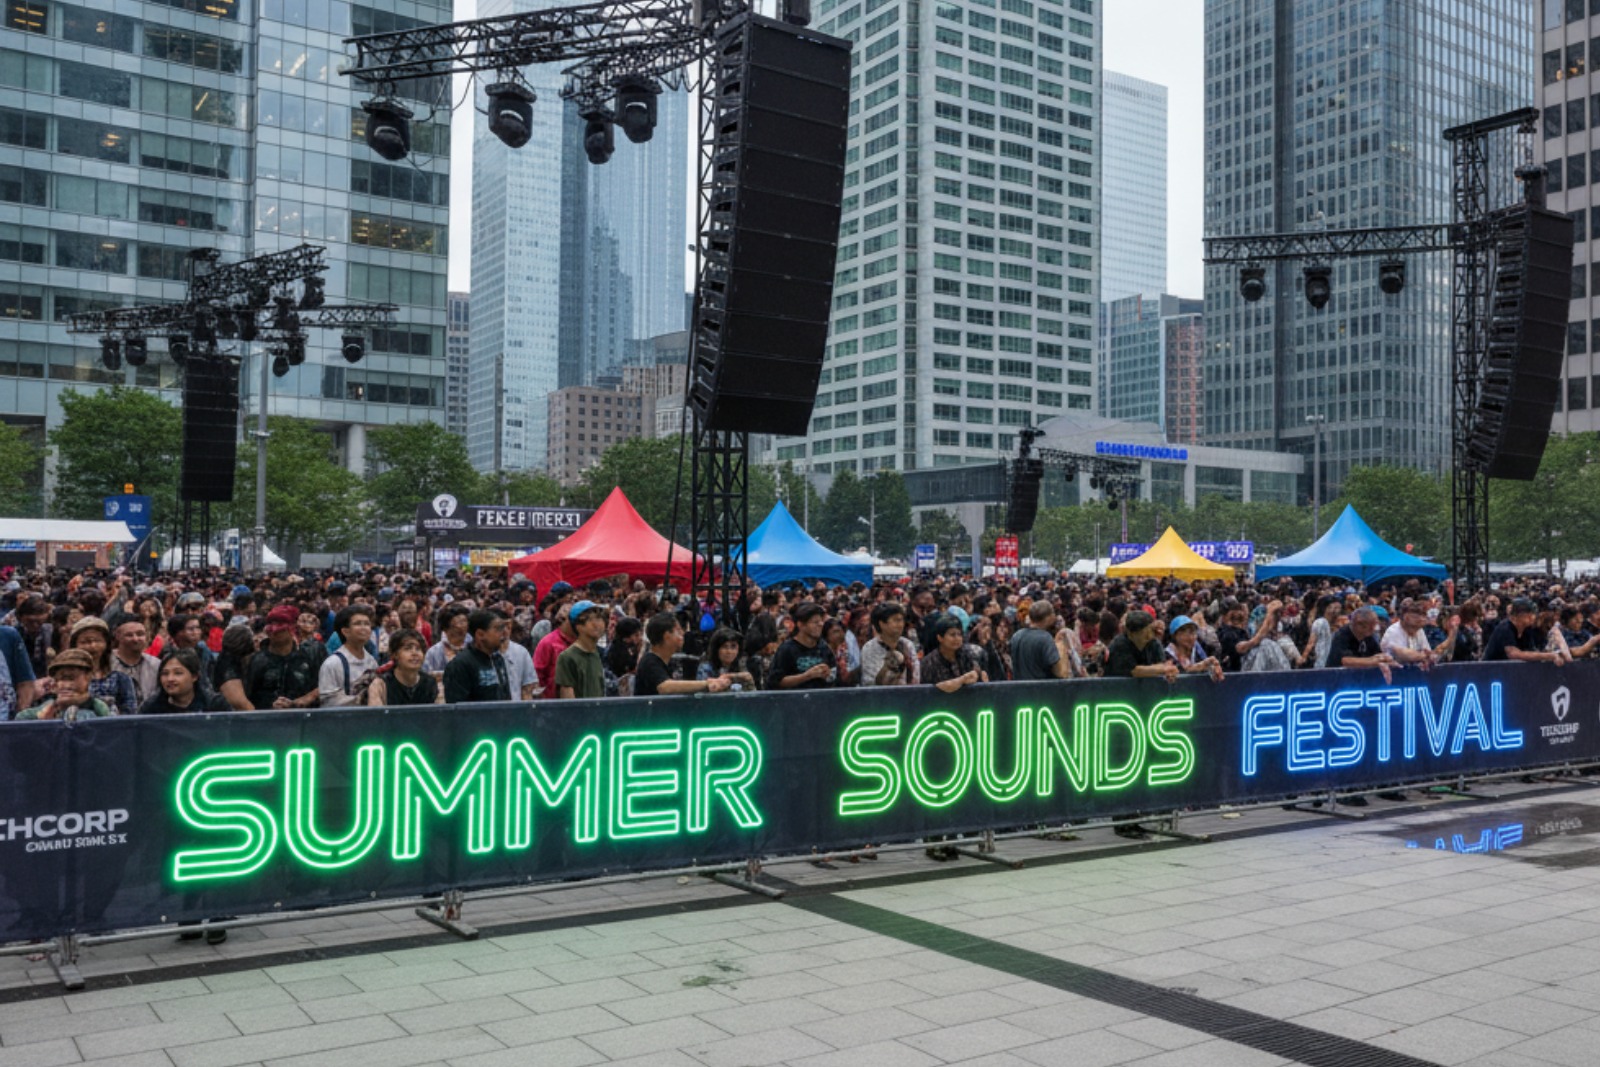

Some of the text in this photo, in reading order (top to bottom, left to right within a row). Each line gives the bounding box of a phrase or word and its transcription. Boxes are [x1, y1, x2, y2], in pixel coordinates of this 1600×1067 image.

[0, 808, 130, 841] HCORP
[173, 683, 1524, 882] SUMMER SOUNDS FESTIVAL
